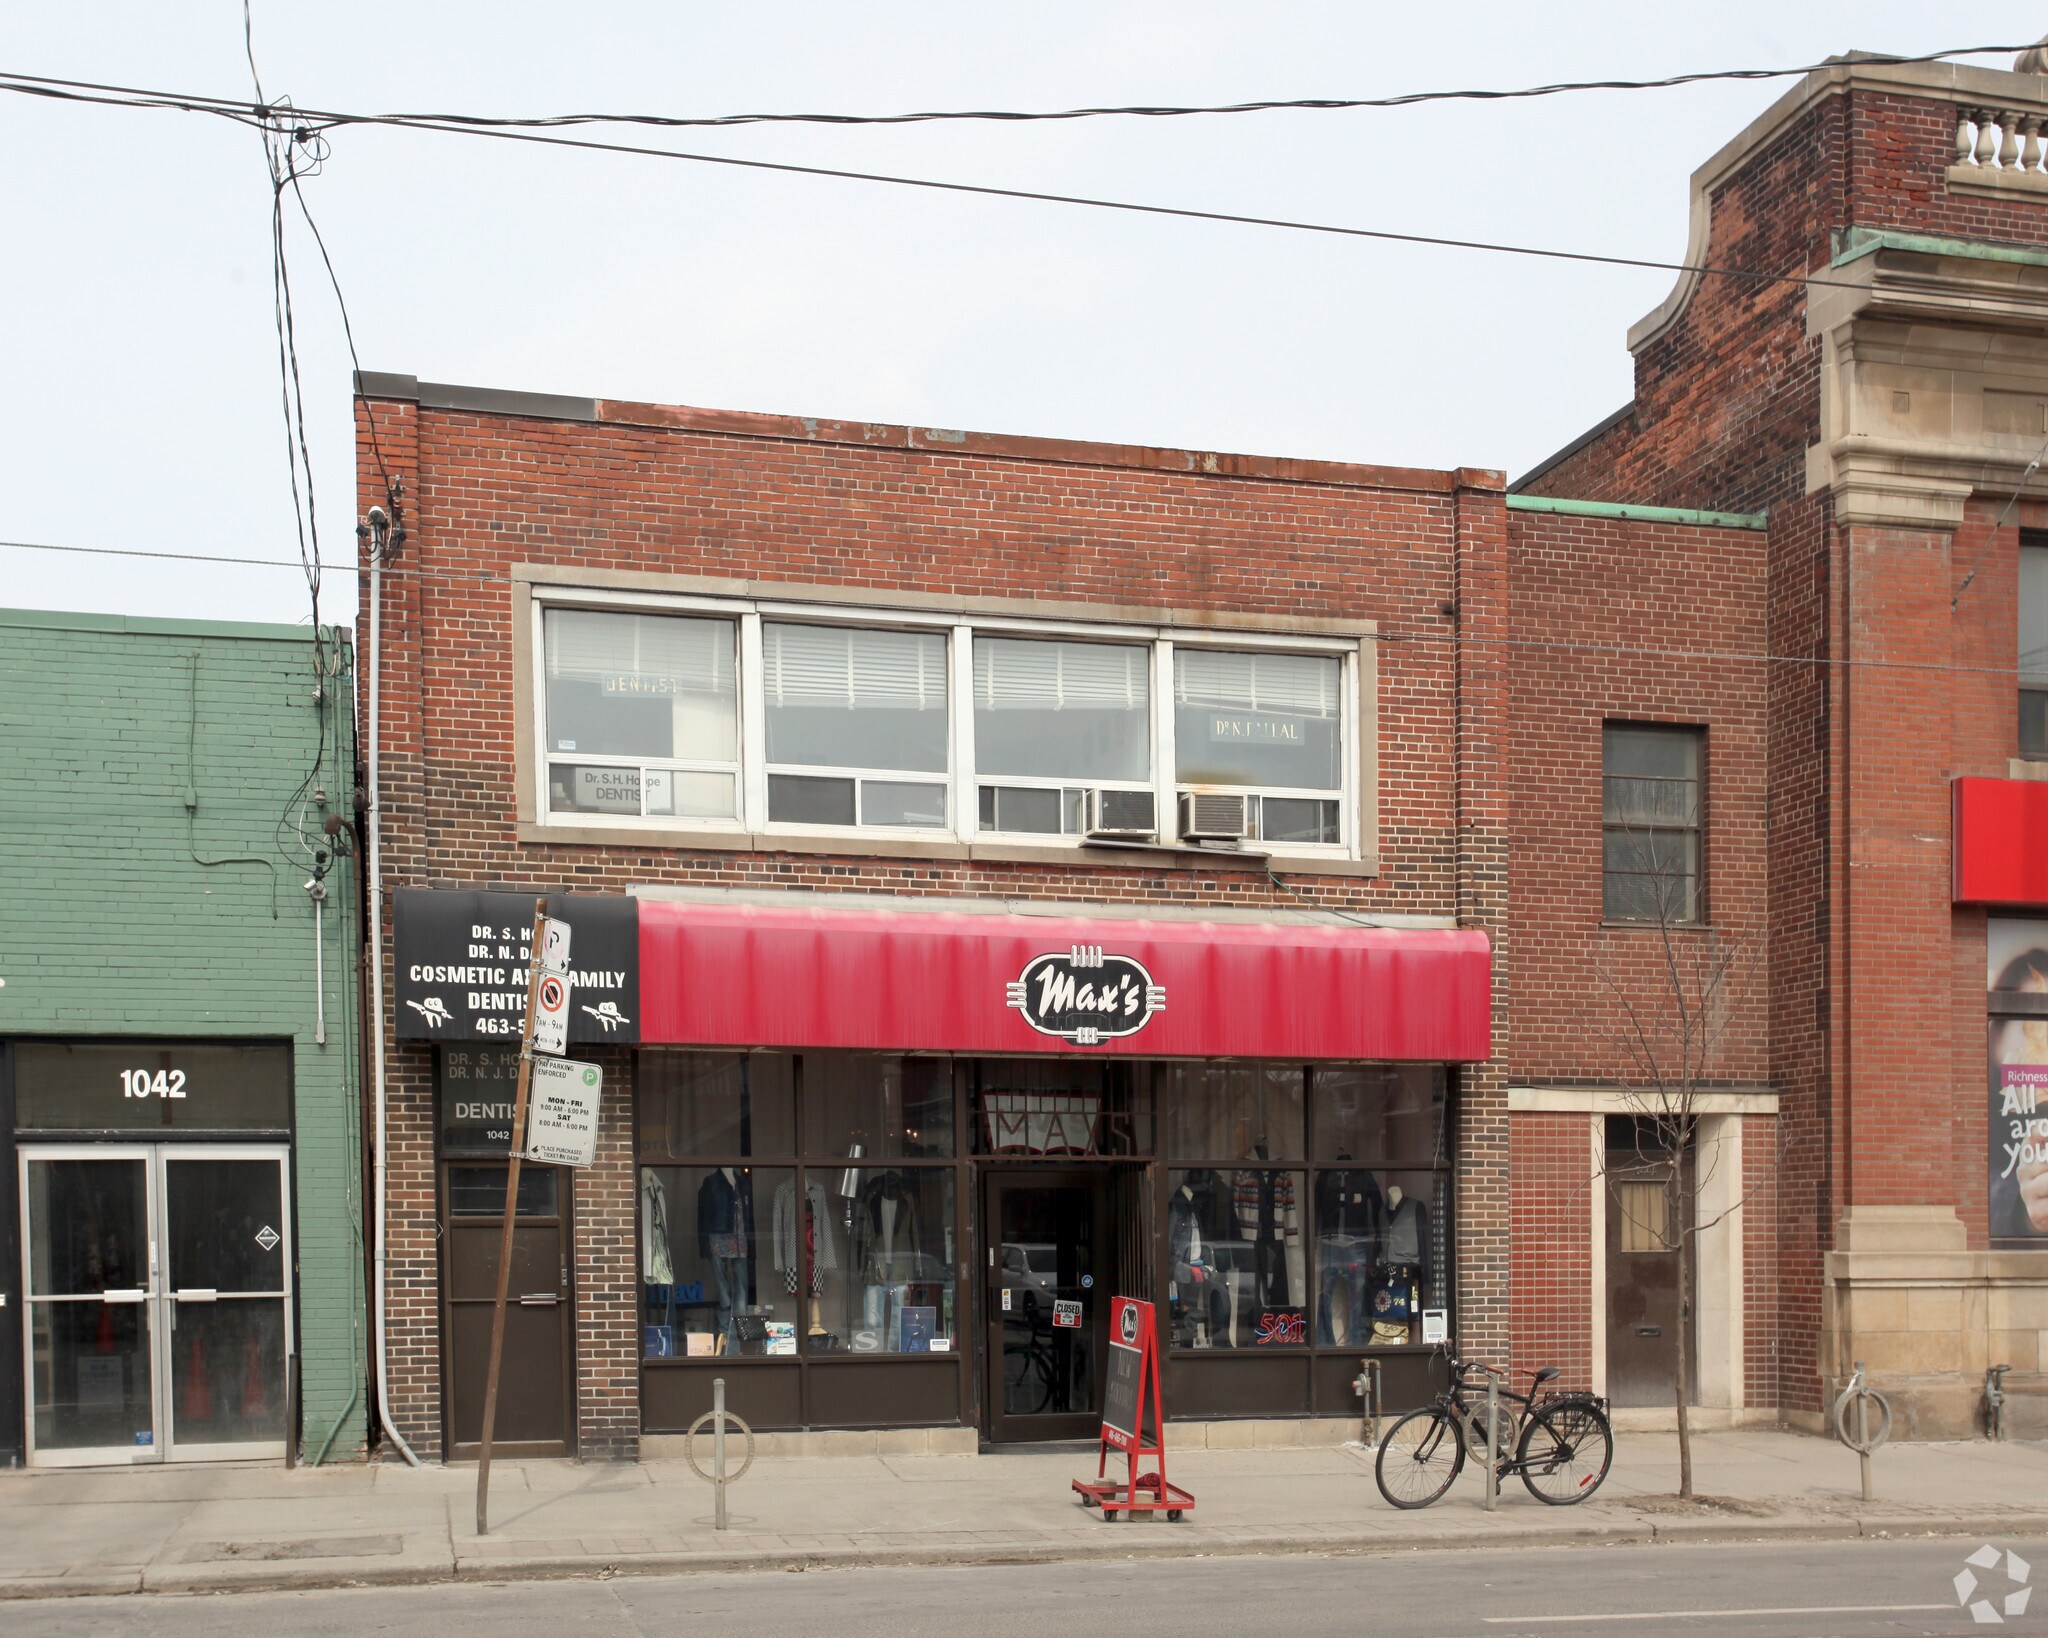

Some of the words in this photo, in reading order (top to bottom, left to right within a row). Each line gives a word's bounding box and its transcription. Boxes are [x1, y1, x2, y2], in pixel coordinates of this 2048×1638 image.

[585, 773, 600, 784] Dr.
[626, 775, 660, 788] Hope
[472, 925, 497, 939] DR.
[502, 927, 516, 940] S.
[468, 944, 494, 959] DR.
[498, 945, 515, 959] N.
[410, 965, 506, 985] COSMETIC
[569, 972, 626, 989] AMILY
[1035, 963, 1140, 1018] Max's
[448, 1053, 472, 1065] DR.
[480, 1053, 493, 1066] S.
[549, 1062, 574, 1071] PARKING
[449, 1067, 470, 1079] DR.
[475, 1067, 488, 1079] N.
[493, 1067, 503, 1079] J.
[538, 1068, 567, 1079] ENFORCED
[2008, 1071, 2048, 1082] Richness
[120, 1069, 187, 1099] 1042
[548, 1096, 565, 1105] MON
[571, 1099, 583, 1107] FRI
[2001, 1083, 2036, 1117] All
[557, 1113, 571, 1121] SAT
[486, 1130, 510, 1140] 1042
[556, 1147, 583, 1155] PURCHASED
[1056, 1303, 1080, 1315] CLOSED
[1257, 1313, 1304, 1344] 501
